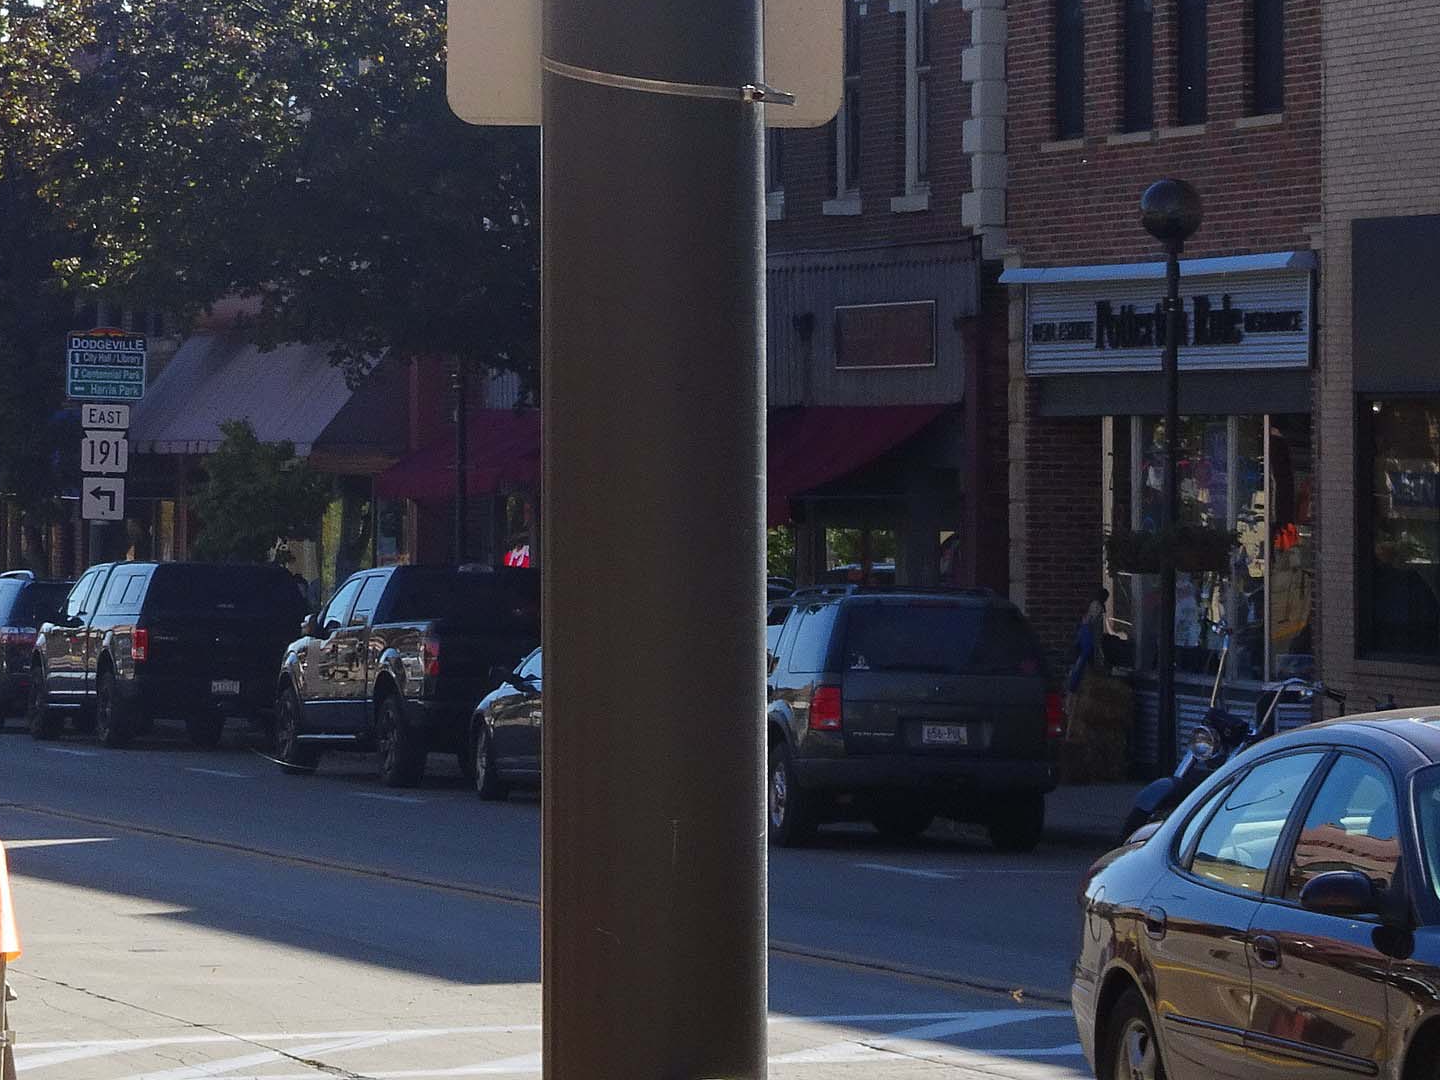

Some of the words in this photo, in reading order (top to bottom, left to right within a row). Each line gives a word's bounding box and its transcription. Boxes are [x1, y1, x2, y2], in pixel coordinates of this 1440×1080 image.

[72, 337, 144, 351] DODGEVILLE
[123, 370, 141, 380] Park
[119, 384, 140, 396] Park
[89, 408, 122, 424] EAST
[89, 439, 120, 466] 191
